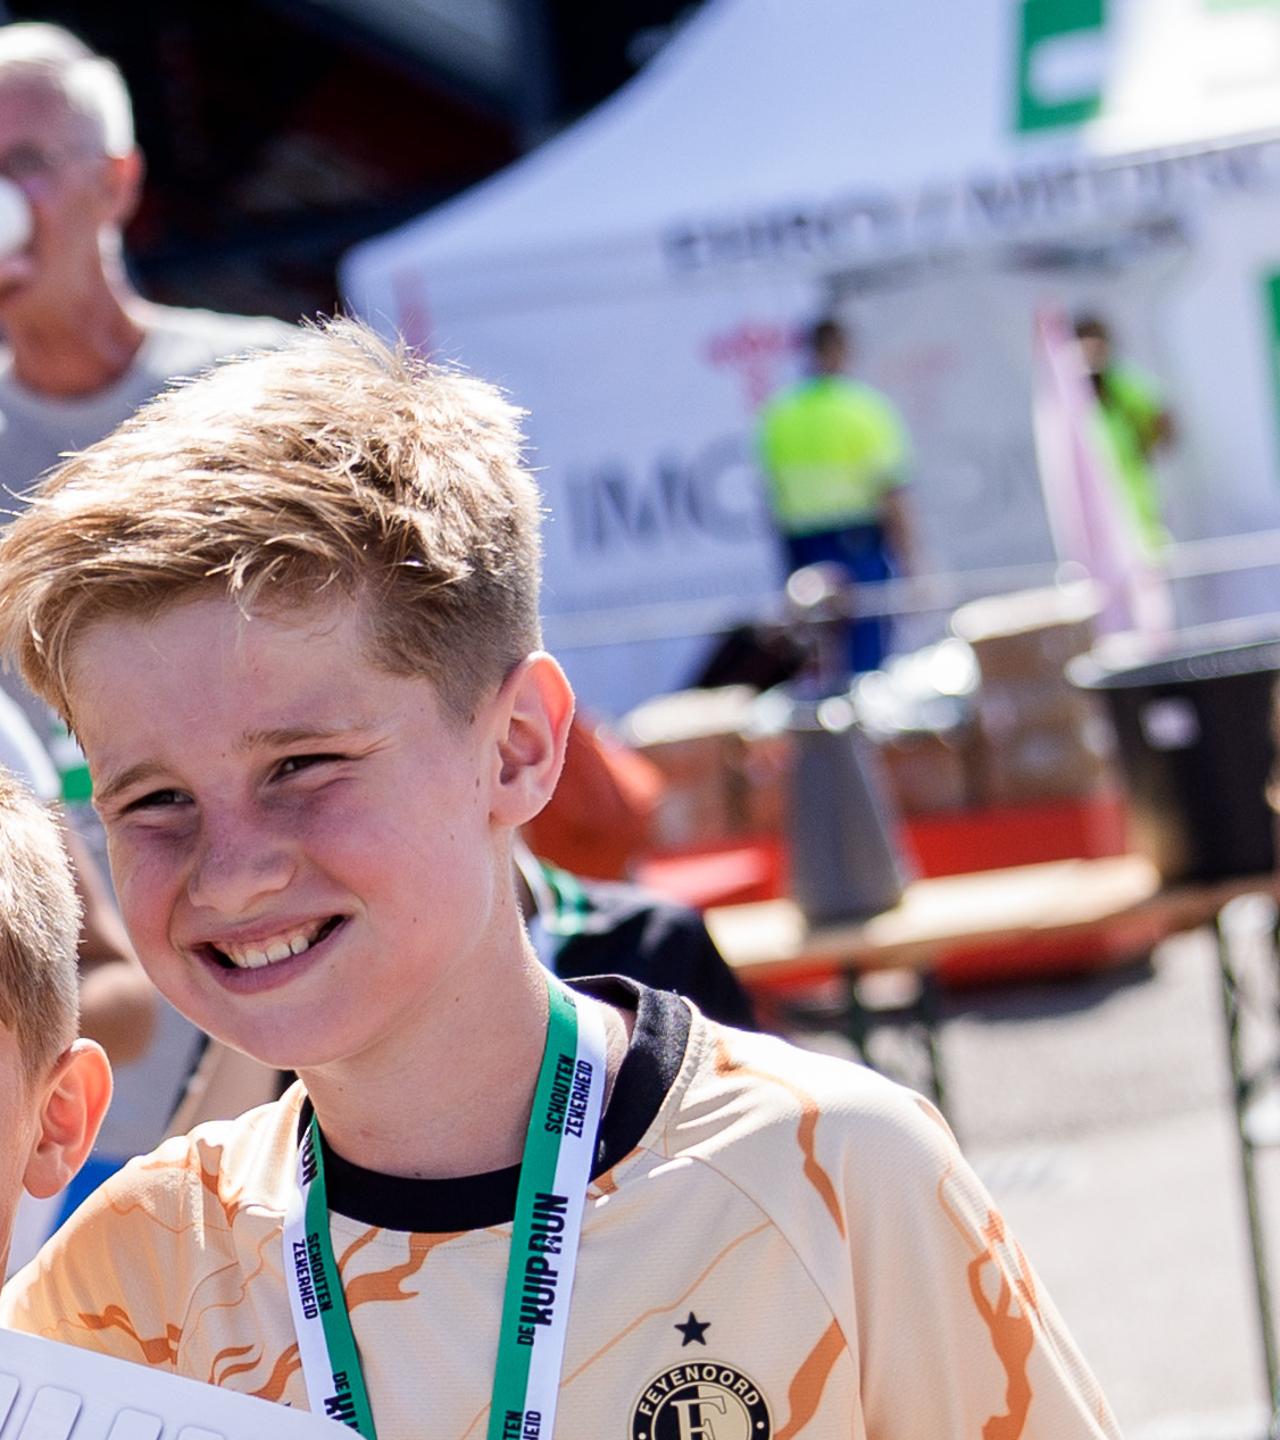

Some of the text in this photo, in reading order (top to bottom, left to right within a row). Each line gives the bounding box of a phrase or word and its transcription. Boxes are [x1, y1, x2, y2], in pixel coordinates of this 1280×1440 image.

[544, 1053, 576, 1134] SCHOUTEN
[564, 1060, 593, 1138] ZEKERHEID
[292, 1239, 319, 1321] ZEKERHEID
[306, 1232, 333, 1314] SCHOUTEN
[517, 1323, 536, 1347] DE
[638, 1365, 760, 1417] FEYENOORD
